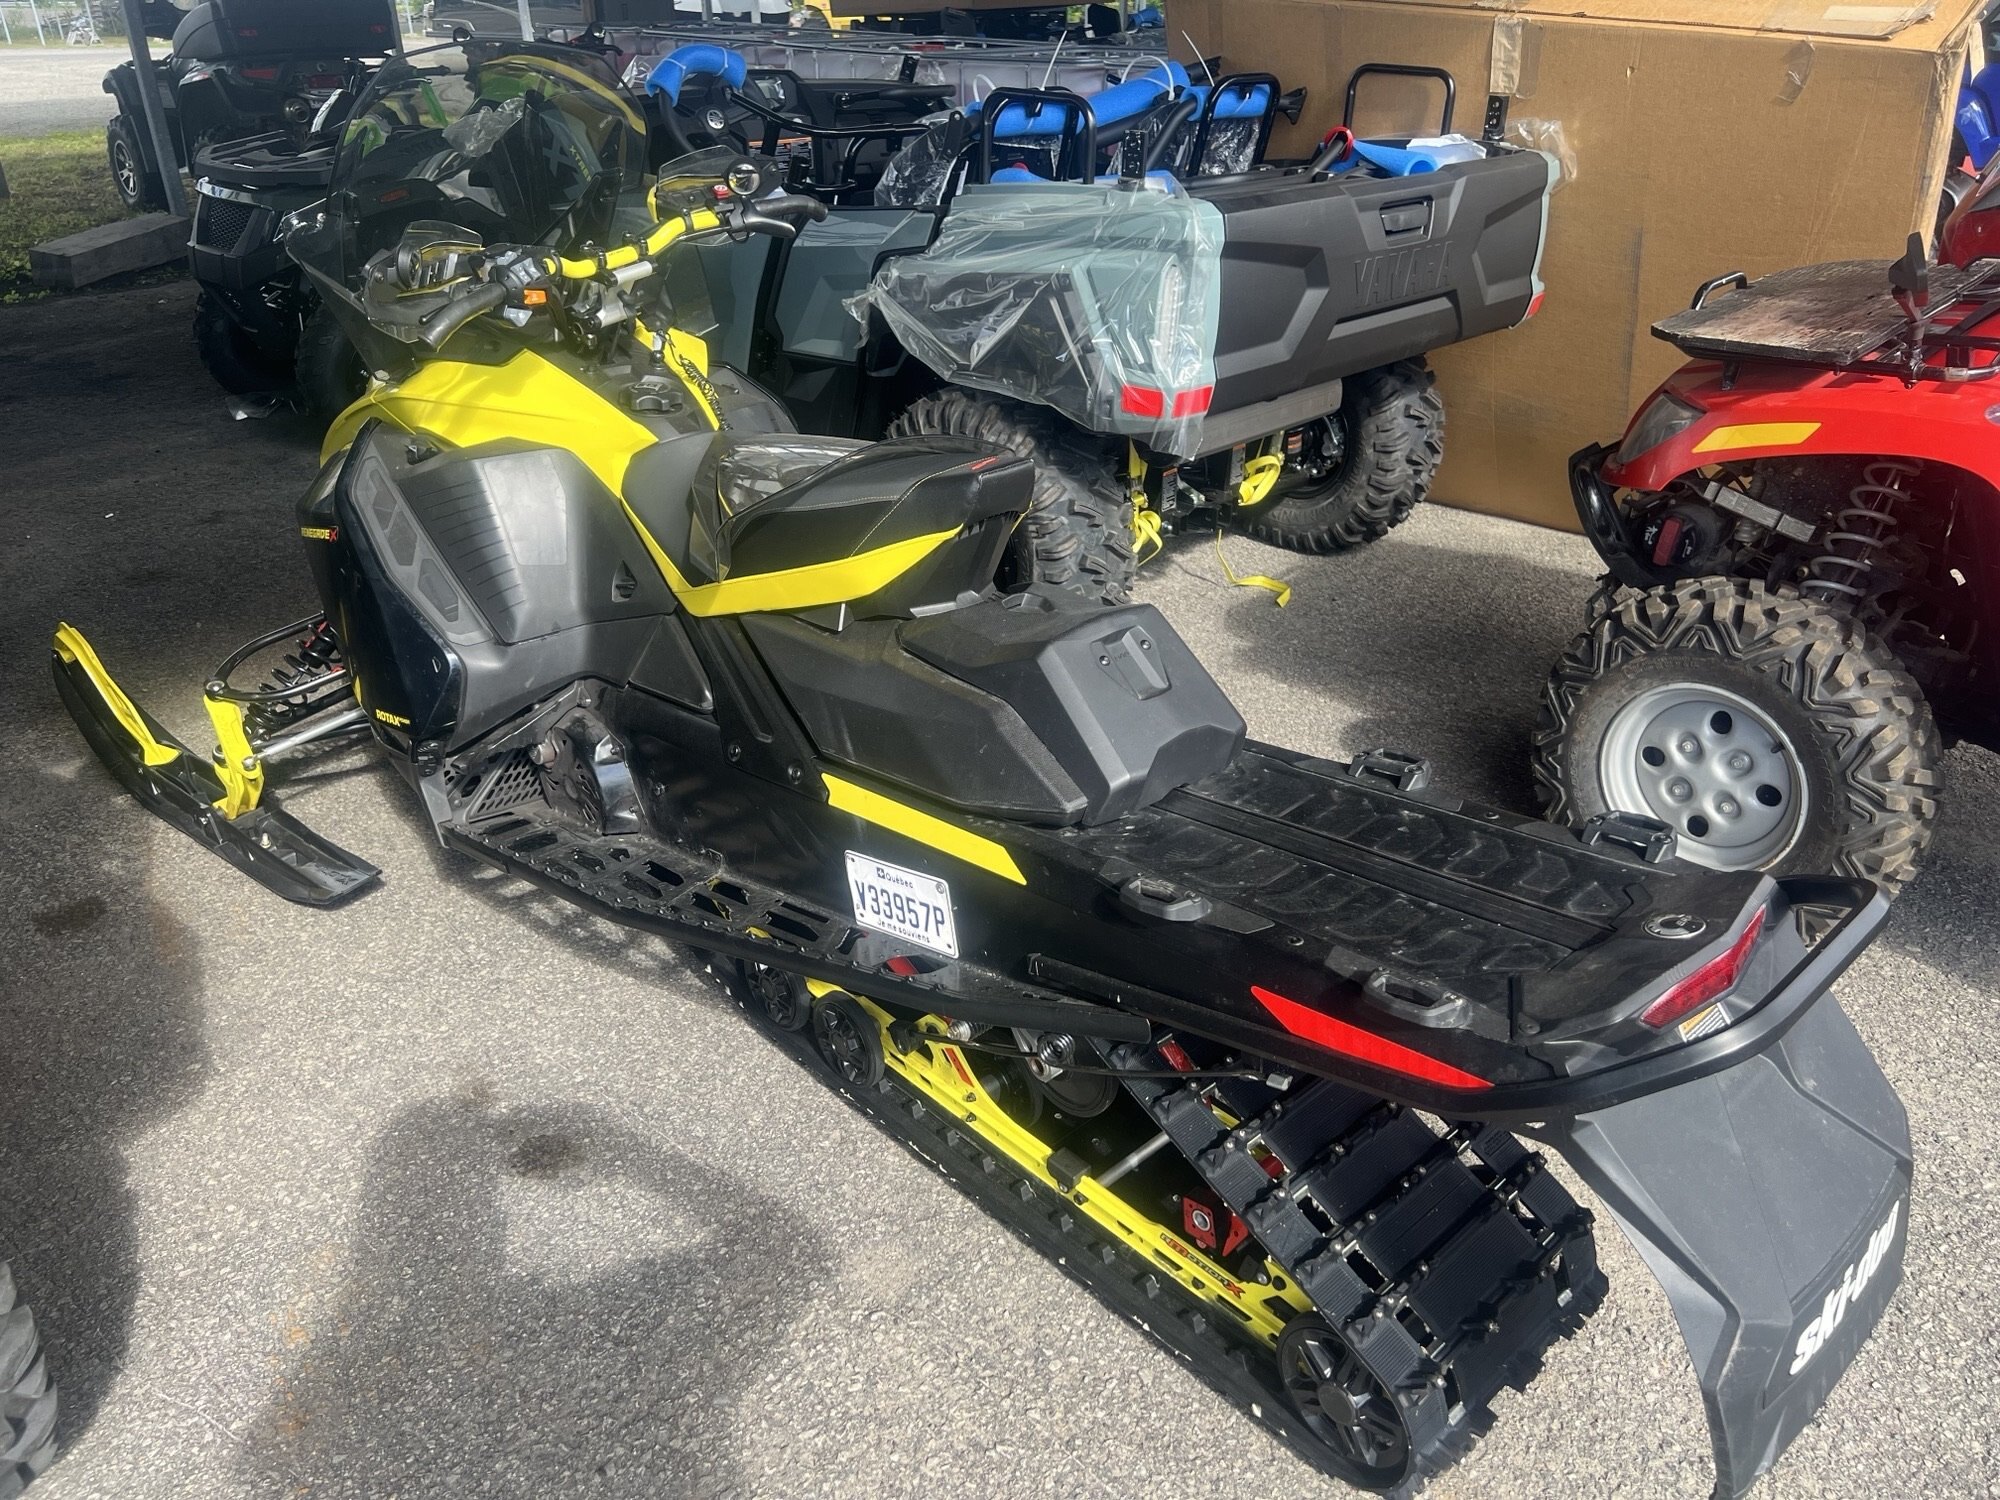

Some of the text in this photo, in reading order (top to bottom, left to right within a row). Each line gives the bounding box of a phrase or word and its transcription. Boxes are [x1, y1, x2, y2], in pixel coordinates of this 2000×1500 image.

[1353, 241, 1453, 308] YAMAHA
[375, 709, 401, 727] ROTAX
[855, 879, 945, 937] V33957P
[885, 871, 914, 889] Québec
[1789, 1199, 1900, 1376] ski-doo
